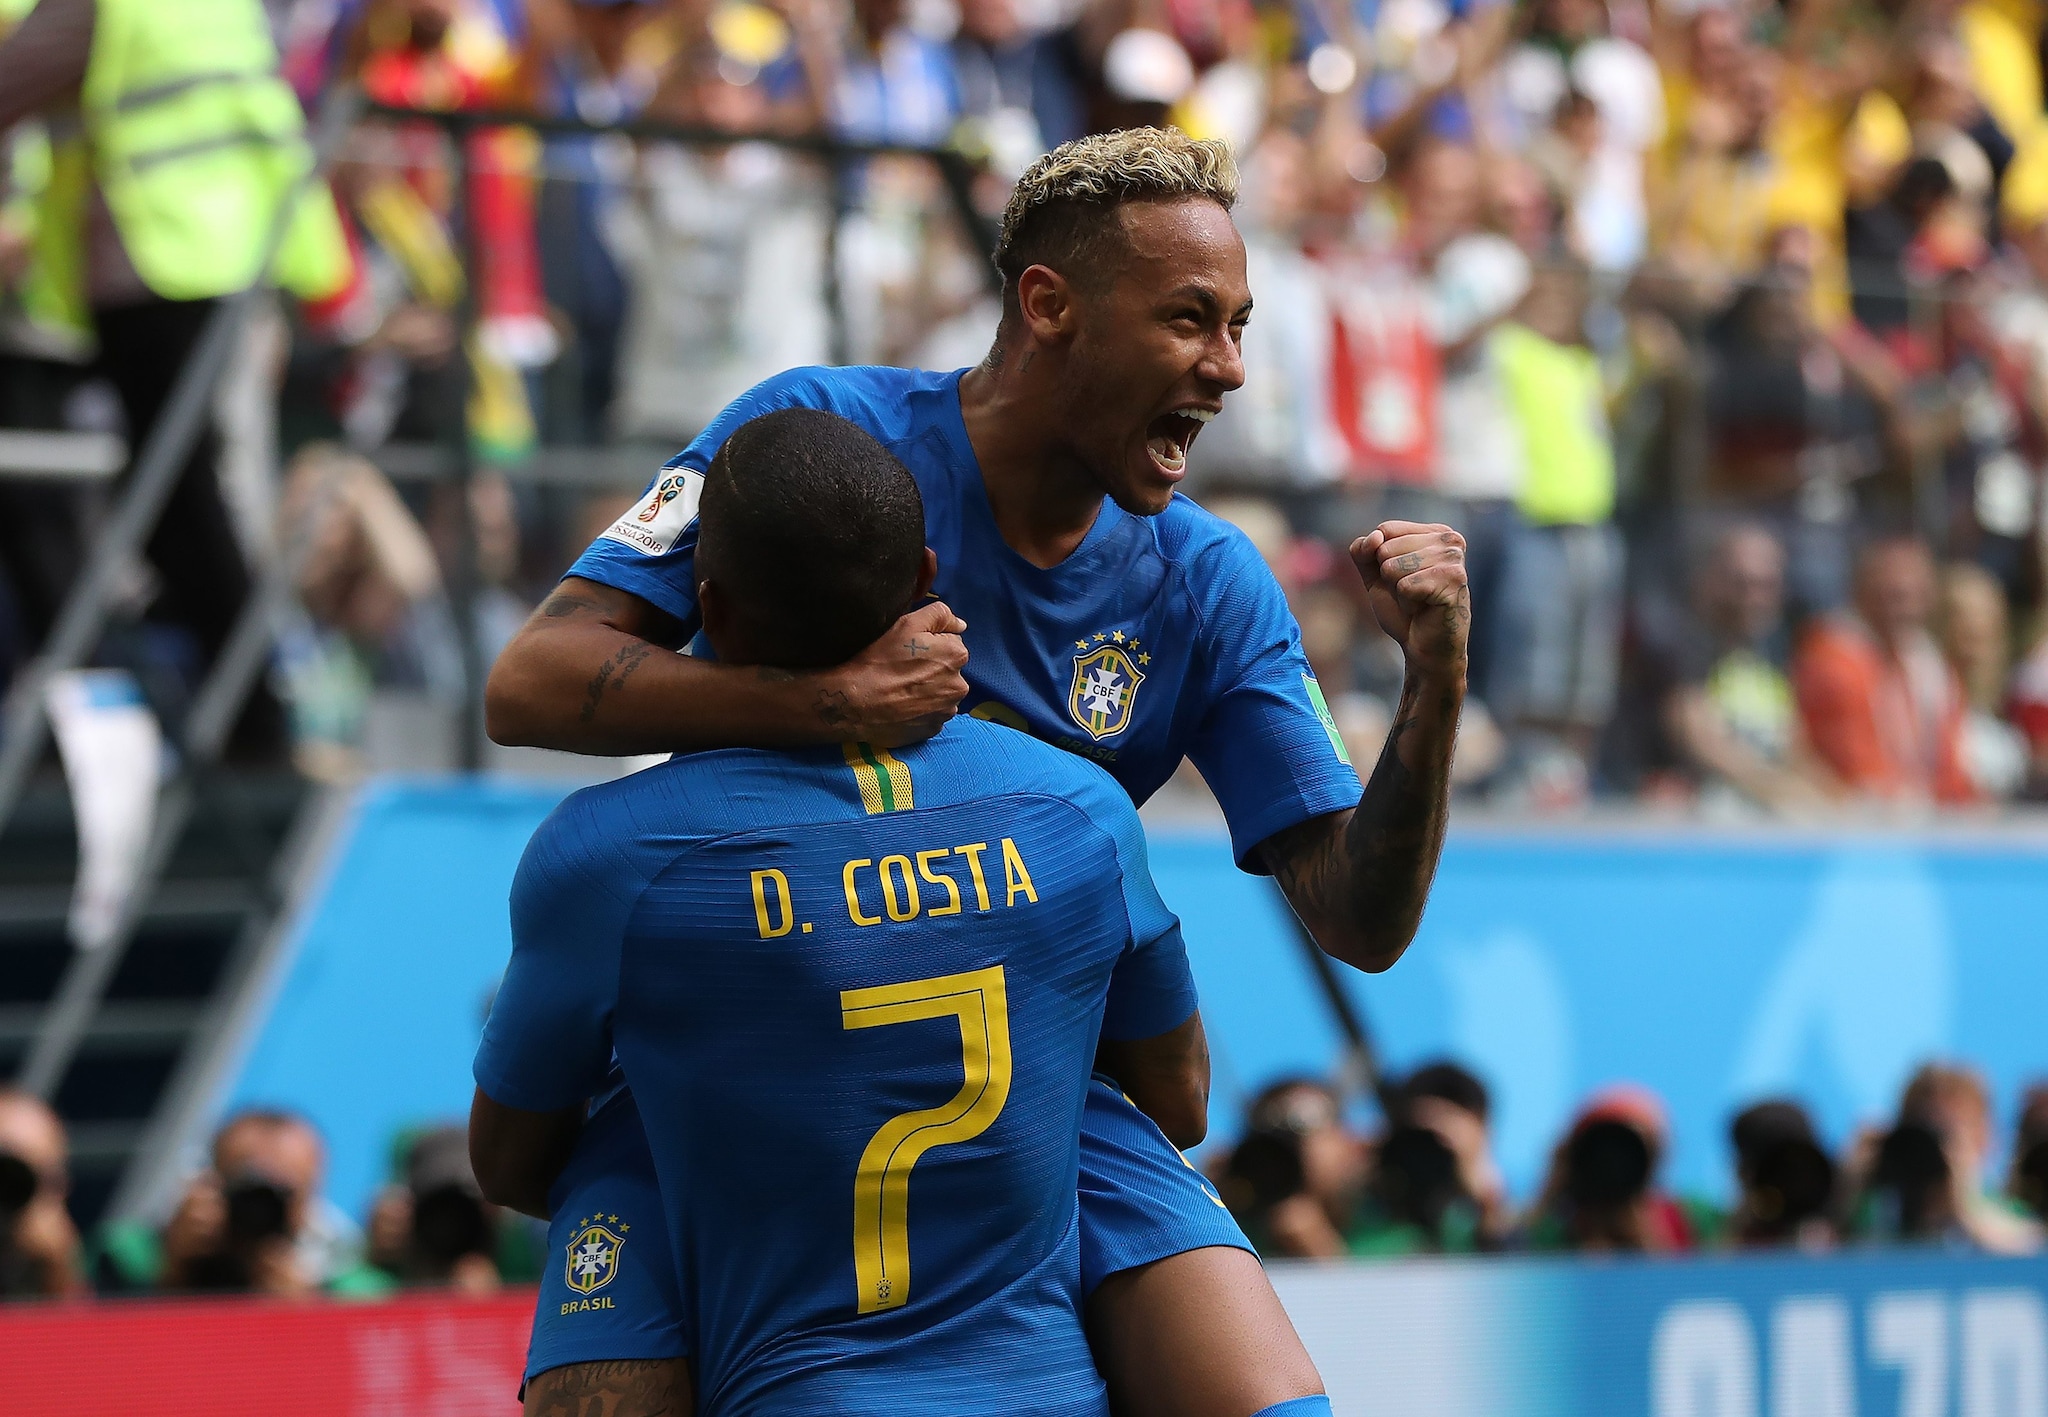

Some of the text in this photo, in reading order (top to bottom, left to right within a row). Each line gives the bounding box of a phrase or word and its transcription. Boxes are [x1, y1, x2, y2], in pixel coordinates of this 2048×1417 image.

[635, 532, 663, 553] 2018
[1092, 684, 1116, 698] CBF
[1059, 736, 1118, 762] BRASIL
[750, 837, 1039, 939] D. COSTA
[839, 964, 1013, 1315] 7
[582, 1253, 601, 1263] CBF
[560, 1296, 616, 1316] BRASIL
